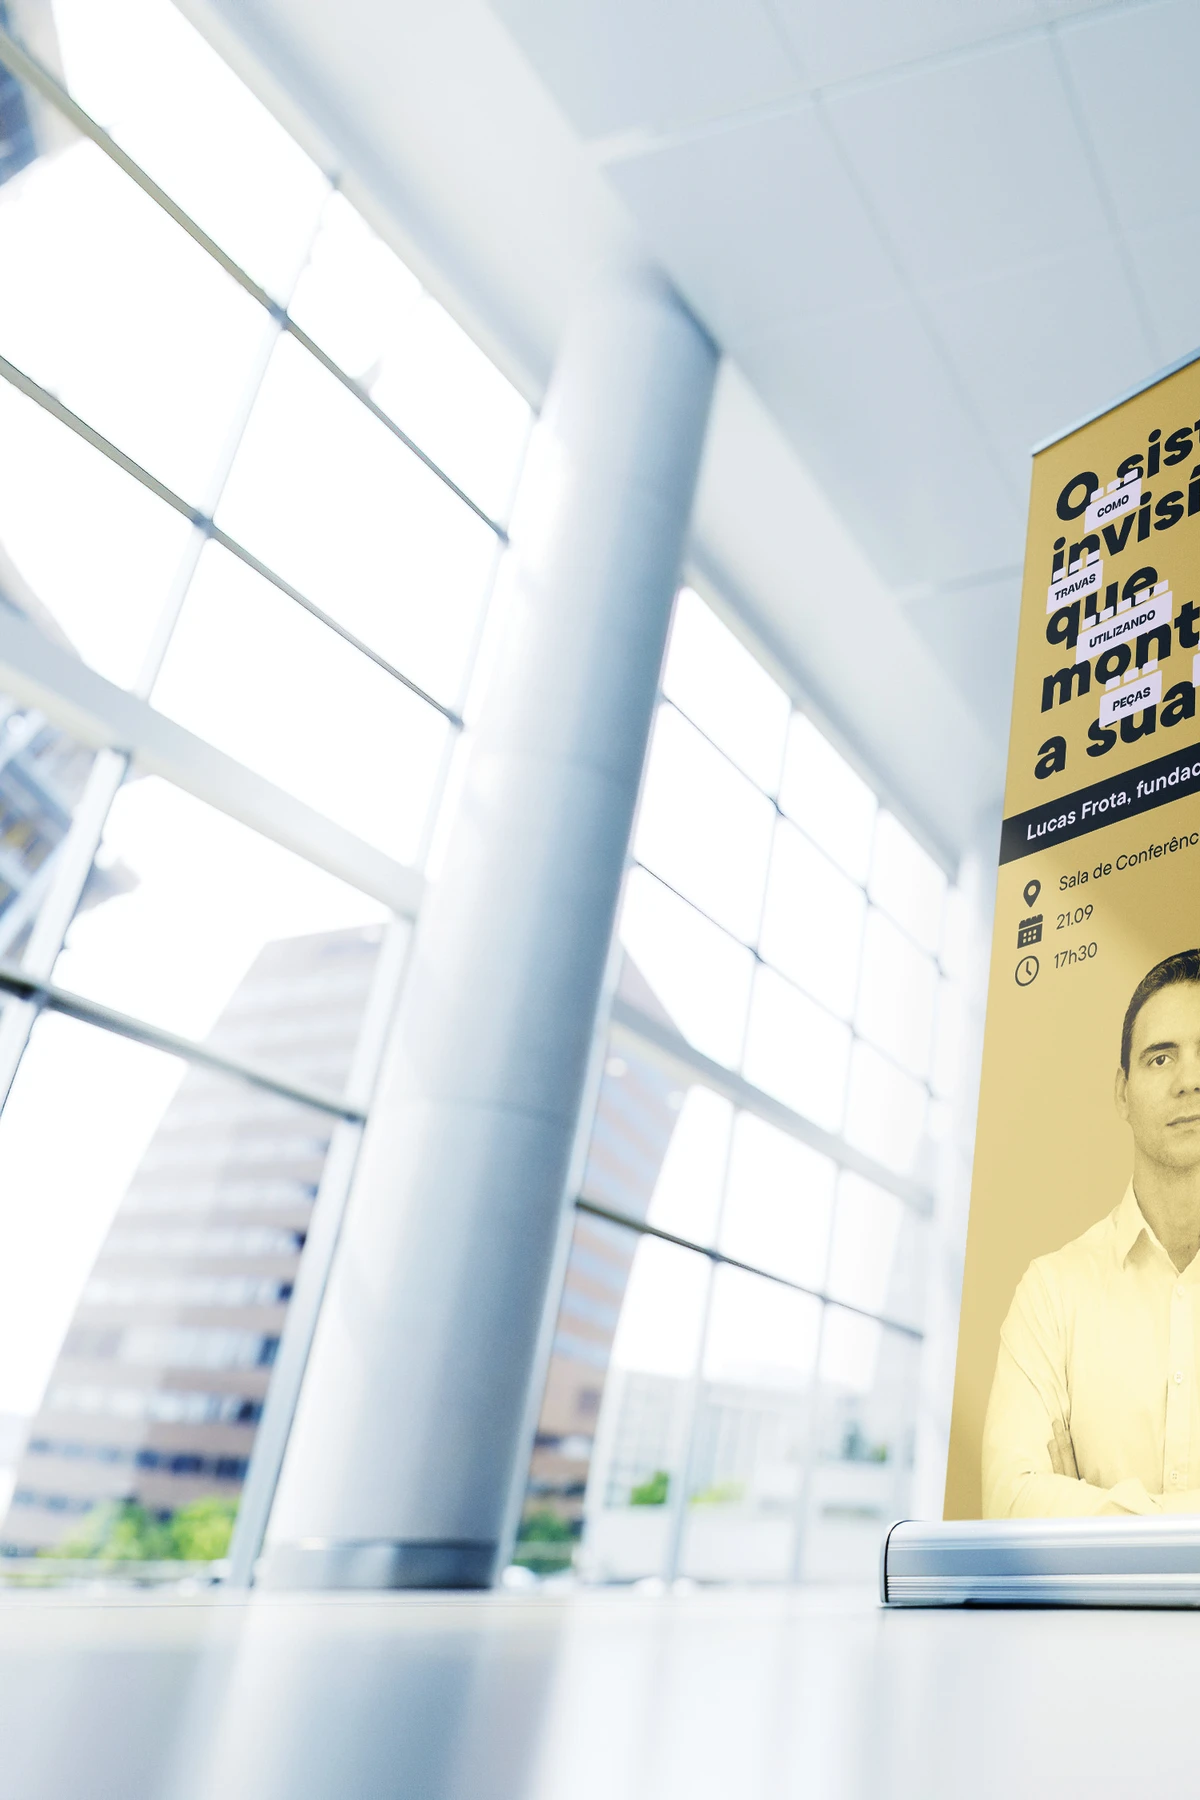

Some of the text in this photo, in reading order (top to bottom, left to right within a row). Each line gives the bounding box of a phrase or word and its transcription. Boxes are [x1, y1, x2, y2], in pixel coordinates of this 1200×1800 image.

[1056, 471, 1099, 521] O
[1097, 494, 1129, 518] COMO
[1054, 573, 1096, 601] TRAVAS
[1046, 566, 1158, 650] que
[1089, 609, 1156, 648] UTILIZANDO
[1112, 687, 1151, 711] PEÇAS
[1034, 735, 1067, 780] a
[1086, 681, 1196, 757] sua
[1026, 809, 1077, 841] Lucas
[1081, 788, 1132, 821] Frota,
[1058, 868, 1089, 892] Sala
[1092, 861, 1112, 880] de
[1056, 904, 1094, 930] 21.09
[1054, 942, 1098, 969] 17h30
